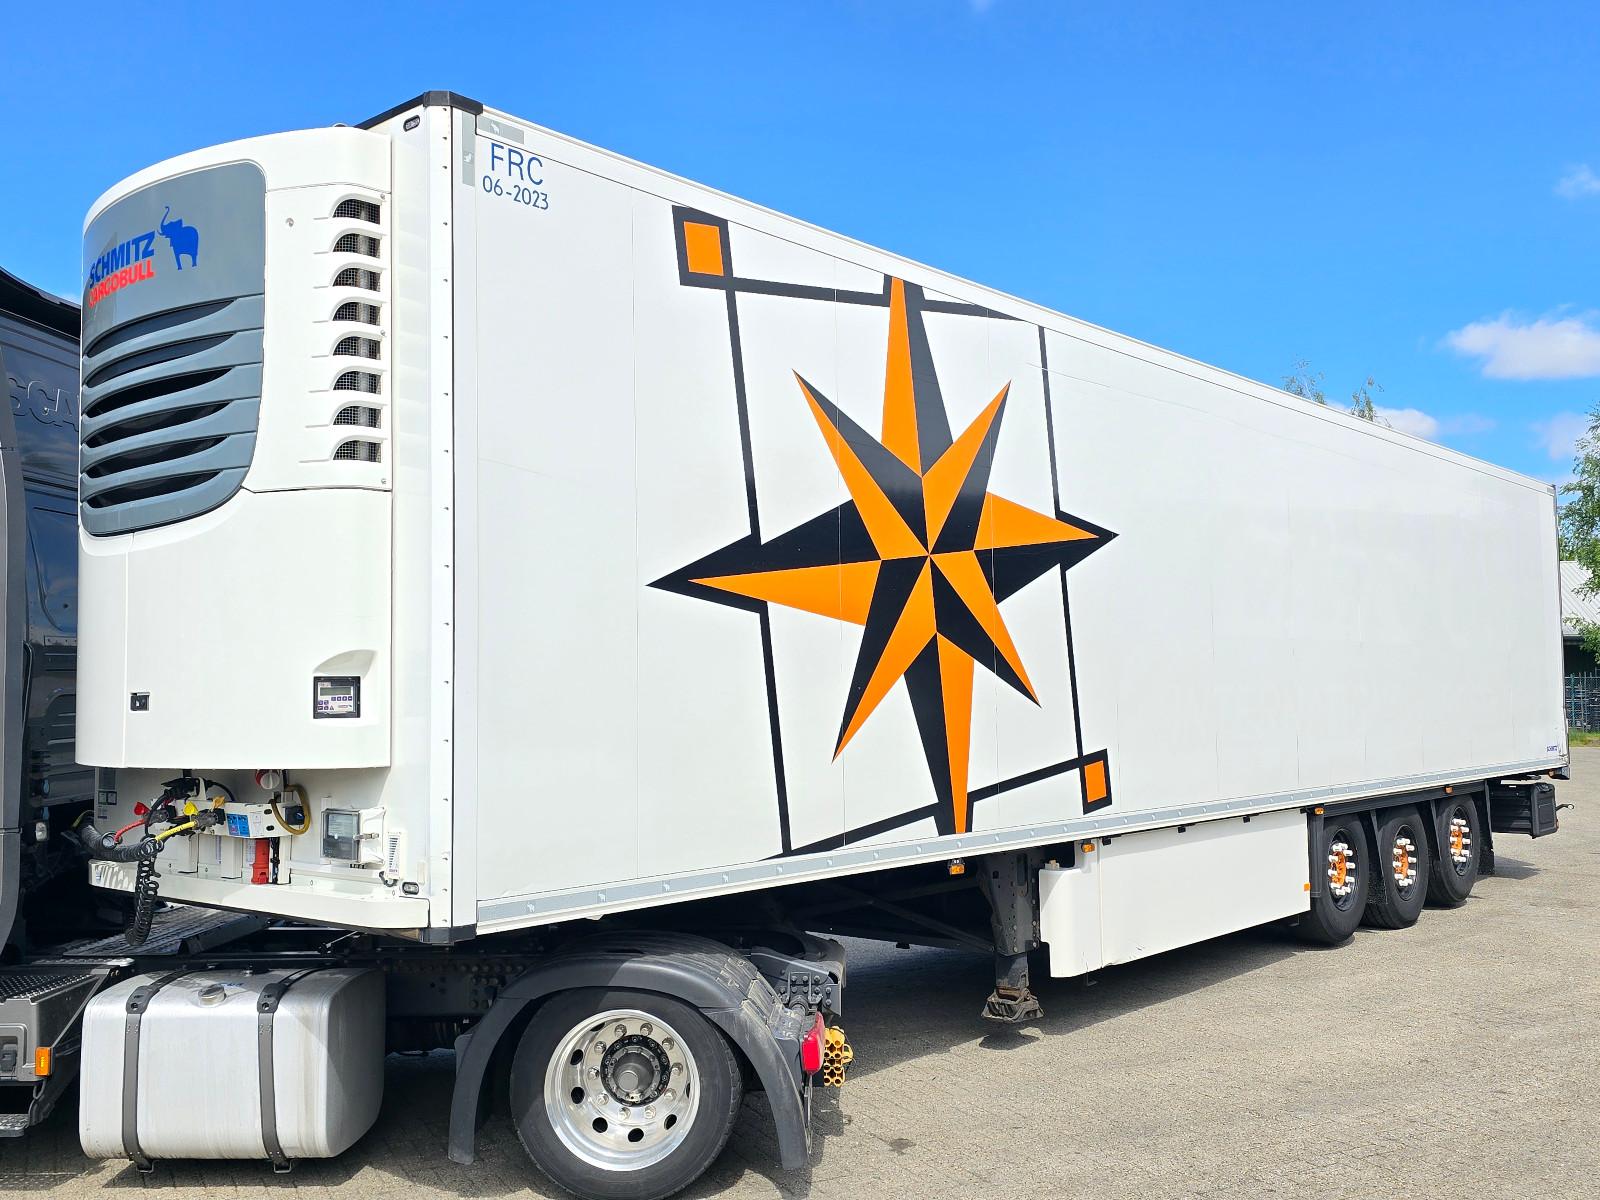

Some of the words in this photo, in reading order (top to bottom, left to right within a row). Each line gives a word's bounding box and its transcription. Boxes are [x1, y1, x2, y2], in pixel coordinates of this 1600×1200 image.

[491, 142, 543, 185] FRC
[483, 175, 549, 210] 06-2023
[89, 230, 155, 289] SCHMITZ
[87, 259, 155, 308] CARGOBULL
